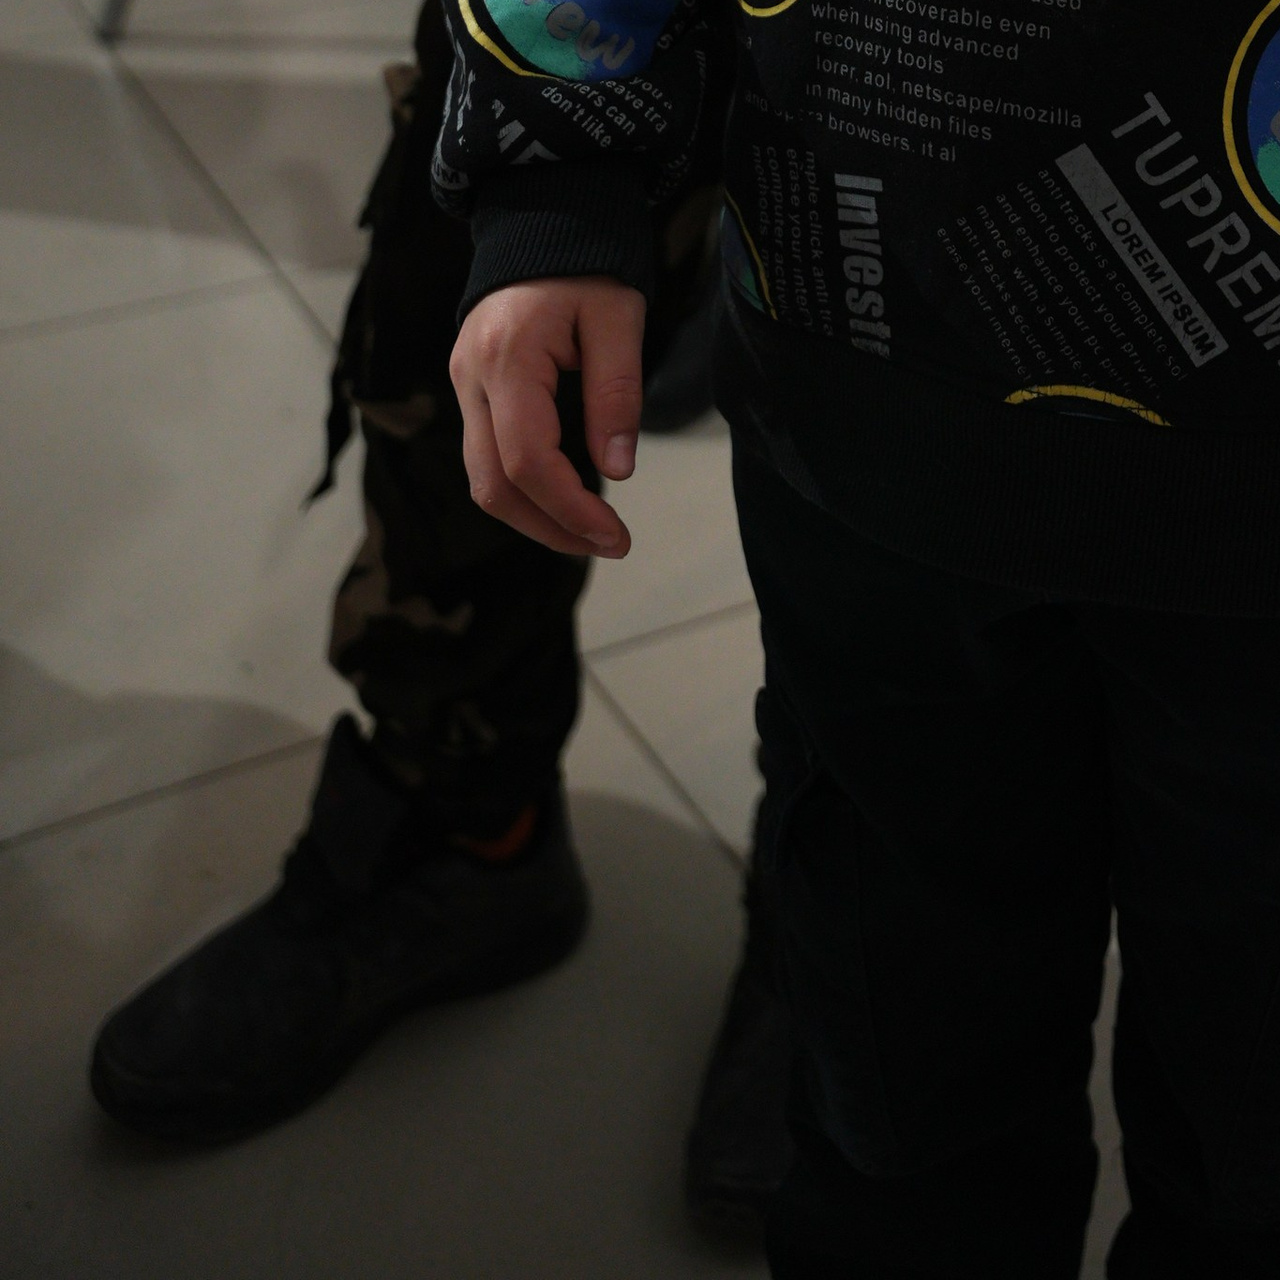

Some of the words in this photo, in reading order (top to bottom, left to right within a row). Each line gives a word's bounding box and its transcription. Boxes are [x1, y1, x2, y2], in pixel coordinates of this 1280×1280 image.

[811, 1, 859, 25] when
[863, 15, 912, 44] using
[917, 28, 1020, 62] advanced
[814, 28, 892, 65] recovery
[896, 48, 945, 74] tools
[999, 18, 1051, 40] even
[541, 85, 585, 123] don't
[580, 114, 613, 149] like
[605, 105, 637, 136] can
[827, 86, 872, 116] many
[877, 97, 942, 130] hidden
[947, 116, 993, 141] files
[902, 77, 1083, 130] netscape/mozilla
[936, 226, 968, 273] erase
[961, 272, 992, 314] your
[973, 245, 1012, 302] tracks
[975, 203, 1012, 259] mance
[1012, 266, 1040, 302] with
[1015, 225, 1064, 294] enhance
[1058, 296, 1091, 332] your
[1059, 196, 1098, 252] tracks
[1114, 280, 1168, 354] complete
[1102, 200, 1167, 284] LOREM
[1157, 282, 1219, 357] IPSUM
[1055, 244, 1101, 303] protect
[1093, 303, 1127, 339] your
